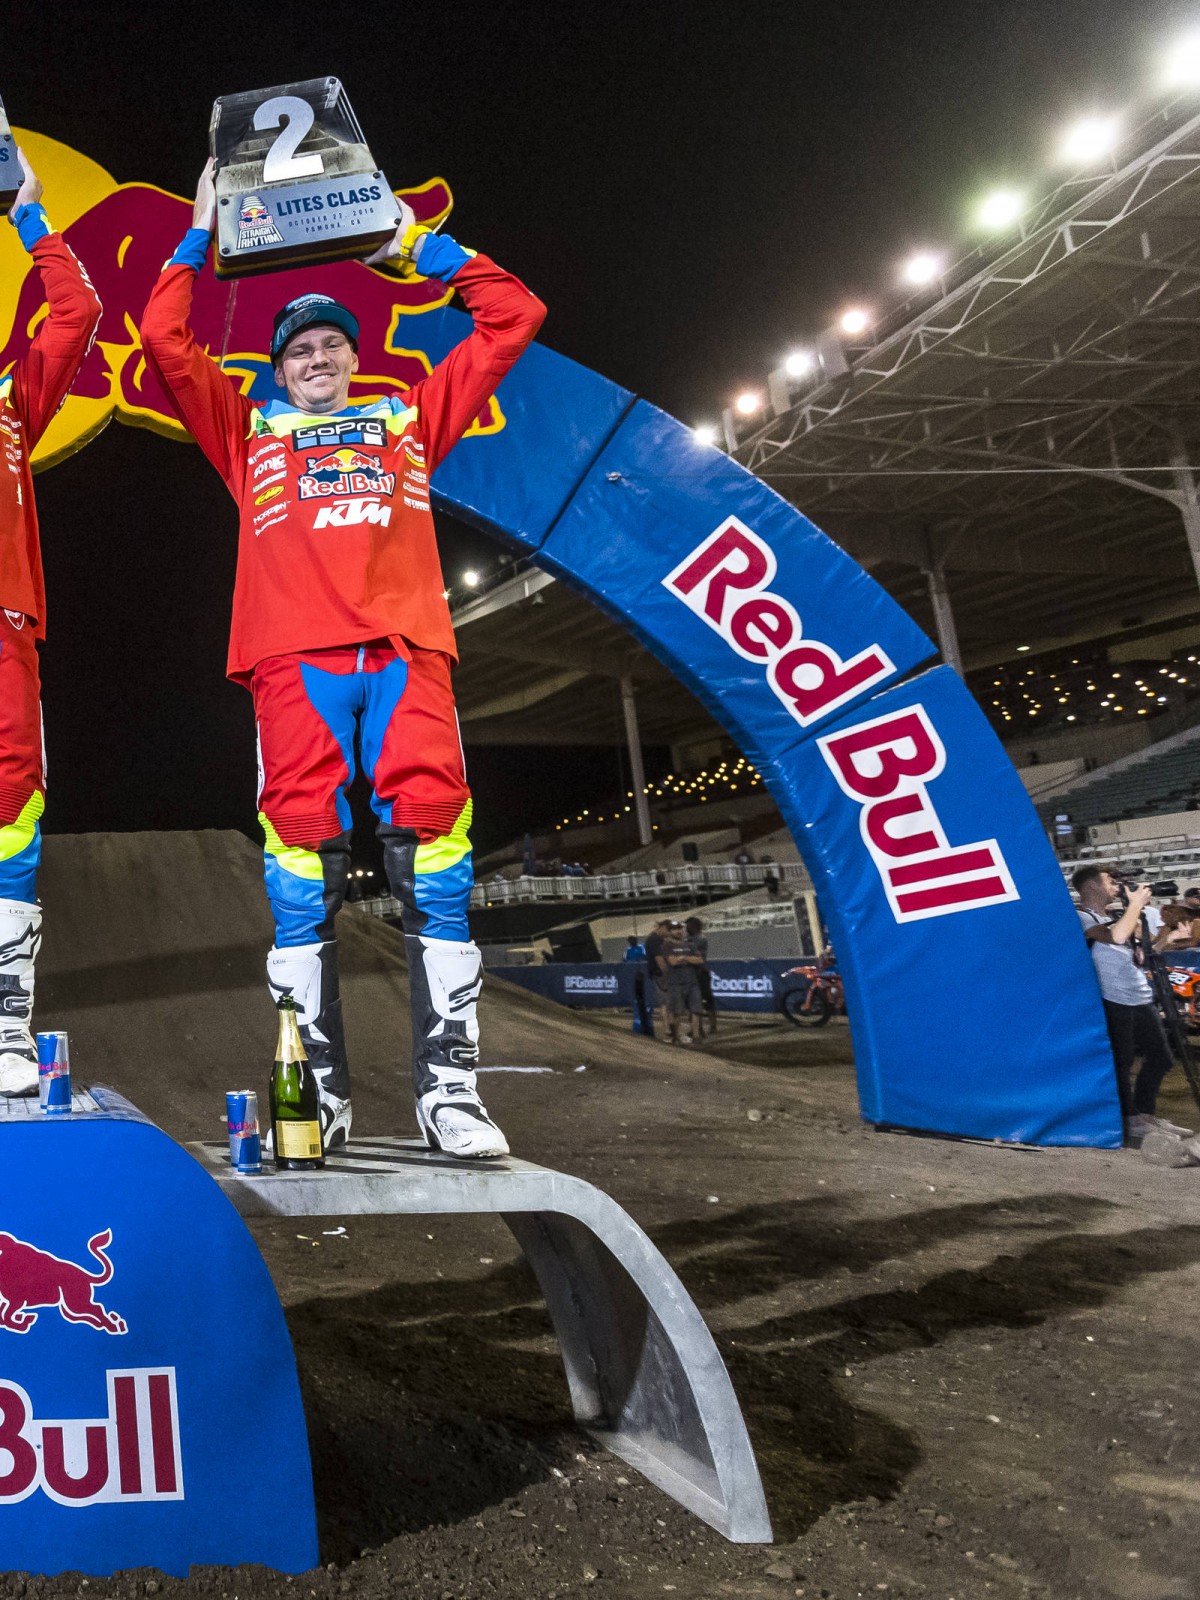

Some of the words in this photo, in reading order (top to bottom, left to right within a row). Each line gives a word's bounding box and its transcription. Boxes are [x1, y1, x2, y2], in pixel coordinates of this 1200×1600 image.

[253, 96, 325, 183] 2
[276, 195, 324, 217] LITES
[326, 185, 382, 208] CLASS
[288, 215, 328, 228] OCTOBER
[240, 226, 276, 239] STRAIGHT
[240, 235, 282, 249] RHYTHM
[296, 422, 384, 438] GoPro
[301, 475, 349, 498] Red
[351, 473, 394, 496] Bull
[312, 497, 393, 529] KTM
[668, 522, 890, 721] Red
[822, 709, 1012, 918] Bull
[710, 974, 773, 992] Goodrich
